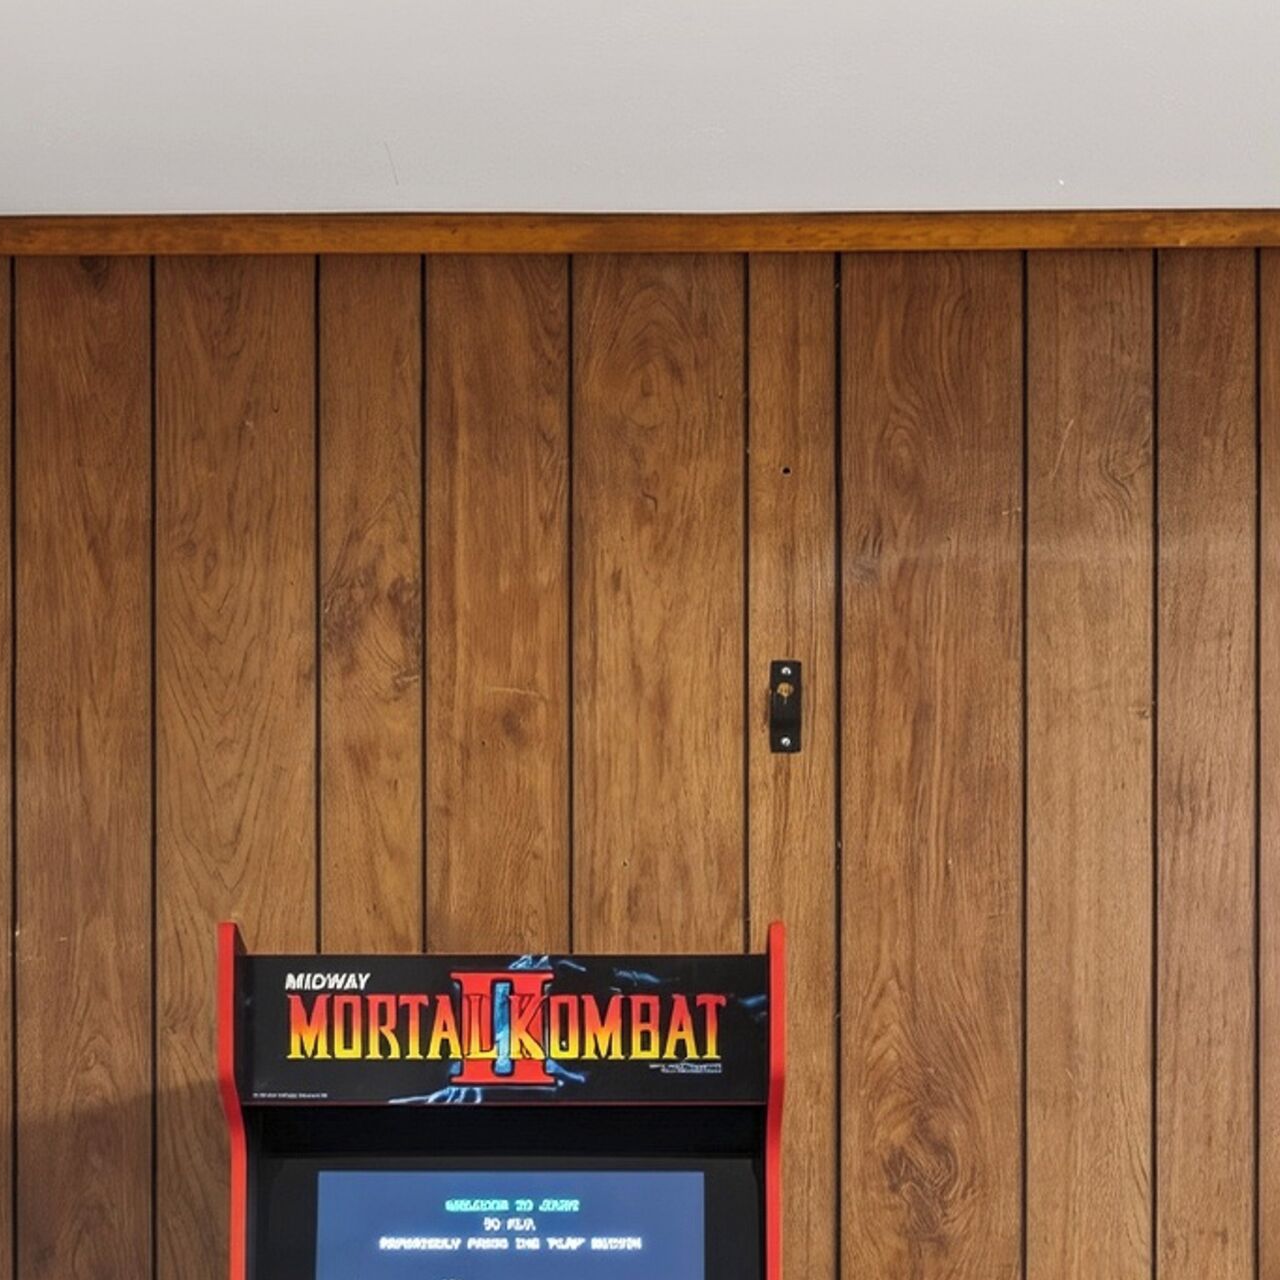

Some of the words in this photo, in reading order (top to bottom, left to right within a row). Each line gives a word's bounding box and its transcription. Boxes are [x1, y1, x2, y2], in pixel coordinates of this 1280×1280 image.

[285, 973, 371, 991] MIDWAY
[286, 993, 500, 1060] MORTAL
[507, 993, 727, 1060] KOMBAT
